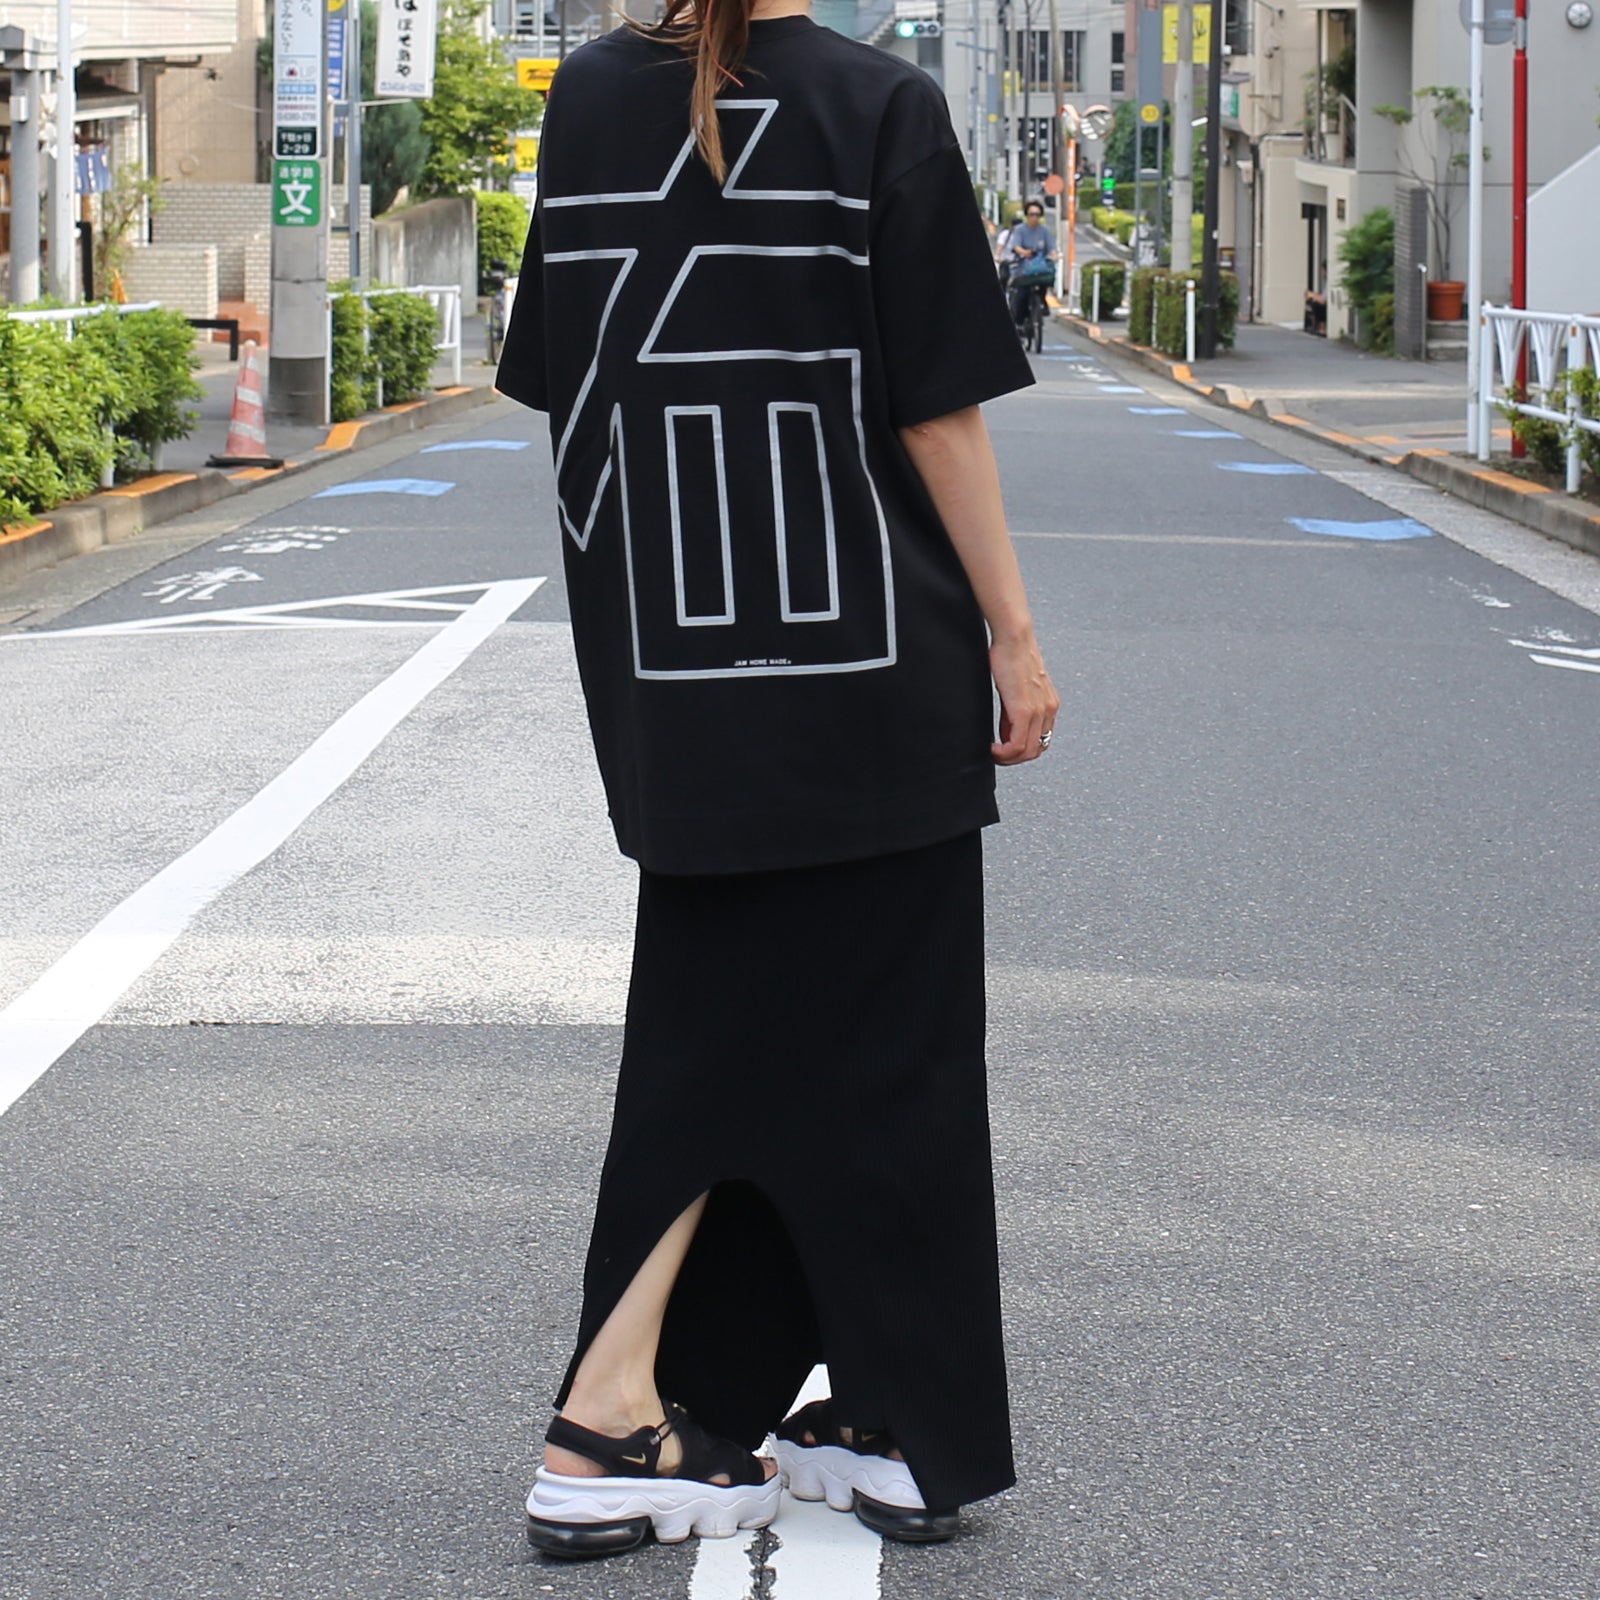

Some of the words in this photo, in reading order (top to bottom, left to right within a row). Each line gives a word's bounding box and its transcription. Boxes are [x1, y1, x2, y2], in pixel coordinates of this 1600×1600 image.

[279, 166, 314, 180] 通学路
[734, 659, 748, 667] JAM
[749, 658, 767, 666] HOME
